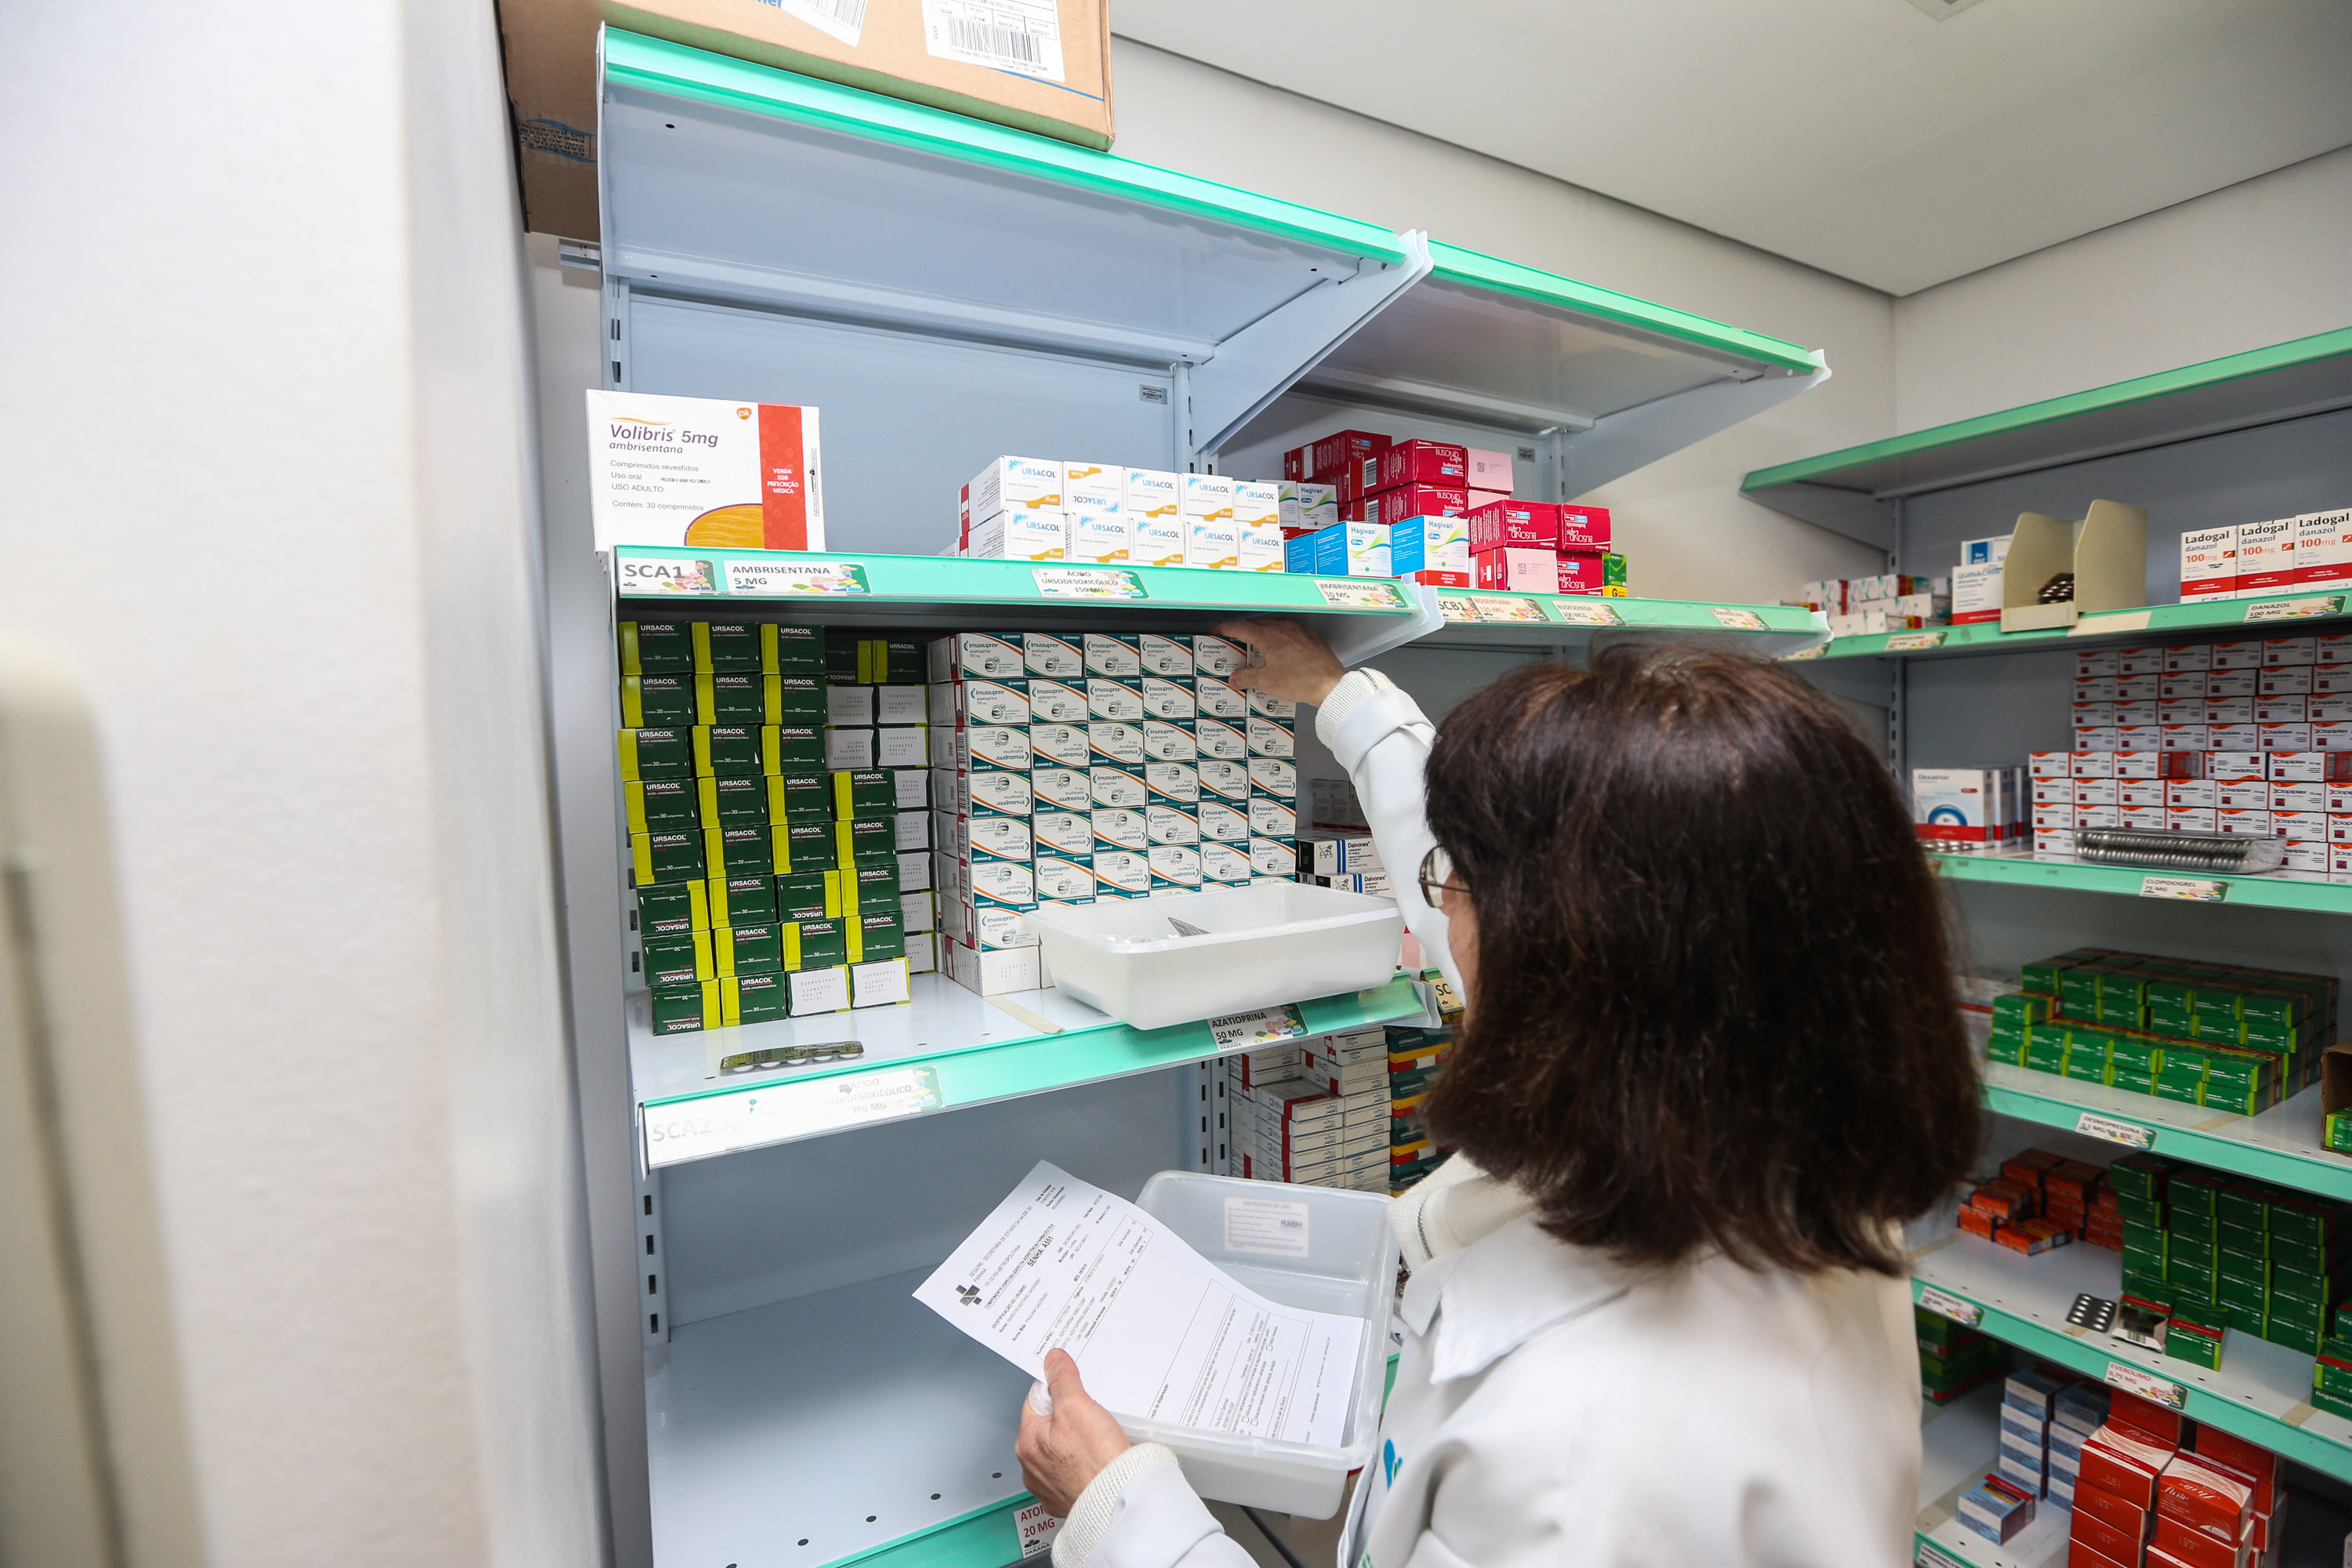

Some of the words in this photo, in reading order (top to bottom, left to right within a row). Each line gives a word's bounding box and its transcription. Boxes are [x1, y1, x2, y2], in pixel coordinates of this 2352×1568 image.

[610, 424, 673, 442] Volibris
[681, 430, 718, 448] 5mg
[609, 442, 683, 454] ambrisentana
[611, 460, 660, 470] Comprimidos
[662, 463, 699, 472] revestidos
[1022, 467, 1056, 478] URSACOL
[632, 485, 664, 493] ADULTO
[1142, 479, 1174, 489] URSACOL
[1200, 485, 1229, 493] URSACOL
[1247, 491, 1275, 499] URSACOL
[1073, 495, 1106, 506] URSACOL
[612, 500, 644, 509] Contém:
[657, 503, 704, 512] comprimidos
[1428, 521, 1454, 529] Hagivan
[2299, 513, 2350, 528] Ladogal
[1026, 521, 1061, 532] URSACOL
[1092, 524, 1125, 533] URSACOL
[2241, 522, 2288, 536] Ladogal
[2299, 526, 2336, 536] danazol
[1149, 528, 1179, 539] URSACOL
[1205, 532, 1234, 541] URSACOL
[2185, 531, 2230, 544] Ladogal
[1252, 538, 1279, 546] URSACOL
[2241, 535, 2275, 545] danazol
[2185, 543, 2217, 553] danazol
[624, 564, 685, 579] SCA1
[732, 565, 831, 575] AMBRISENTANA
[1320, 583, 1378, 592] AMBRISENTANA
[2146, 879, 2196, 889] CLOPIDOGREL
[655, 923, 689, 931] URSACOL
[1212, 1012, 1267, 1028] AZATIOPRINA
[667, 1022, 700, 1030] URSACOL
[1215, 1031, 1227, 1040] 50
[1229, 1029, 1243, 1037] MG
[870, 1102, 887, 1112] MG
[1025, 1246, 1046, 1268] SENHA:
[1041, 1234, 1054, 1248] A551
[2111, 1363, 2151, 1381] EVEROLIMO
[1024, 1526, 1036, 1537] 20
[1037, 1518, 1055, 1533] MG
